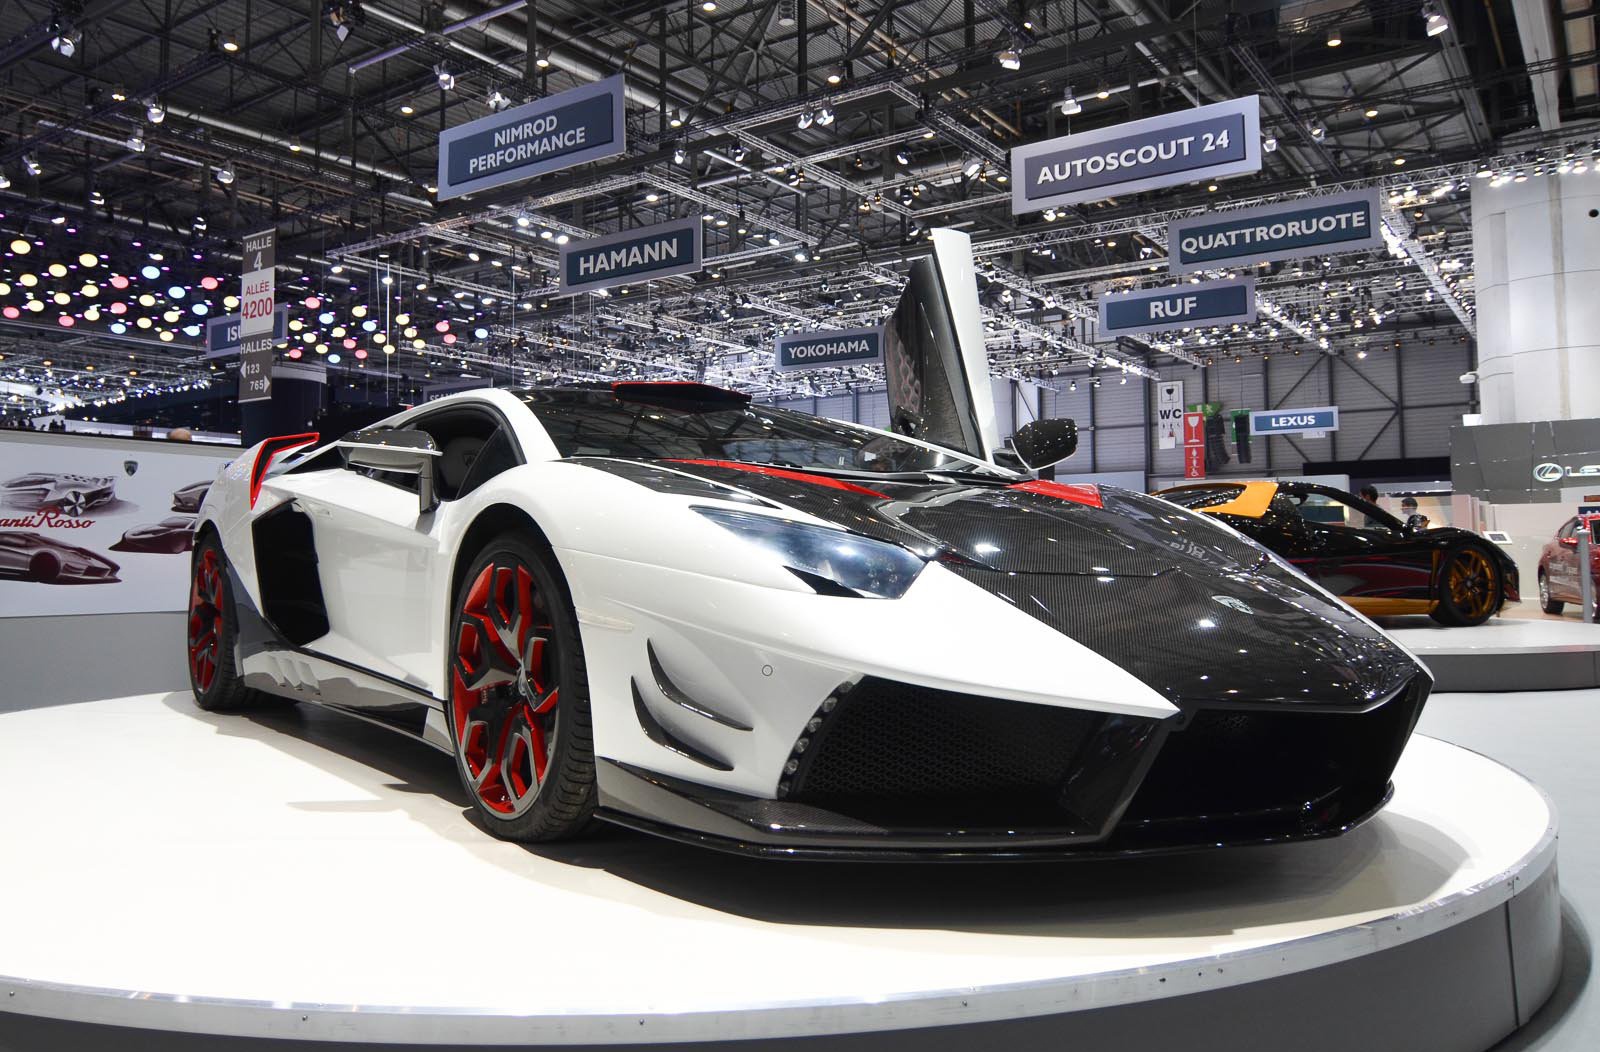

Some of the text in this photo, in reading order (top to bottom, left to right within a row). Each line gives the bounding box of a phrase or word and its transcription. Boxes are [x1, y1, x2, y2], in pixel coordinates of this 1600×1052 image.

[494, 115, 558, 148] NIMROD
[469, 127, 586, 174] PERFORMANCE
[1036, 129, 1230, 185] AUTOSCOUT 24
[1181, 212, 1366, 254] QUATTRORUOTE
[246, 236, 272, 252] HALLE
[253, 251, 262, 271] 4
[579, 238, 678, 276] HAMANN
[245, 279, 270, 297] ALLÉE
[242, 297, 273, 320] 4200
[1149, 296, 1198, 319] RUF
[240, 338, 273, 355] HALLES
[788, 340, 870, 359] YOKOHAMA
[1159, 408, 1182, 420] WC
[1271, 415, 1316, 428] LEXUS
